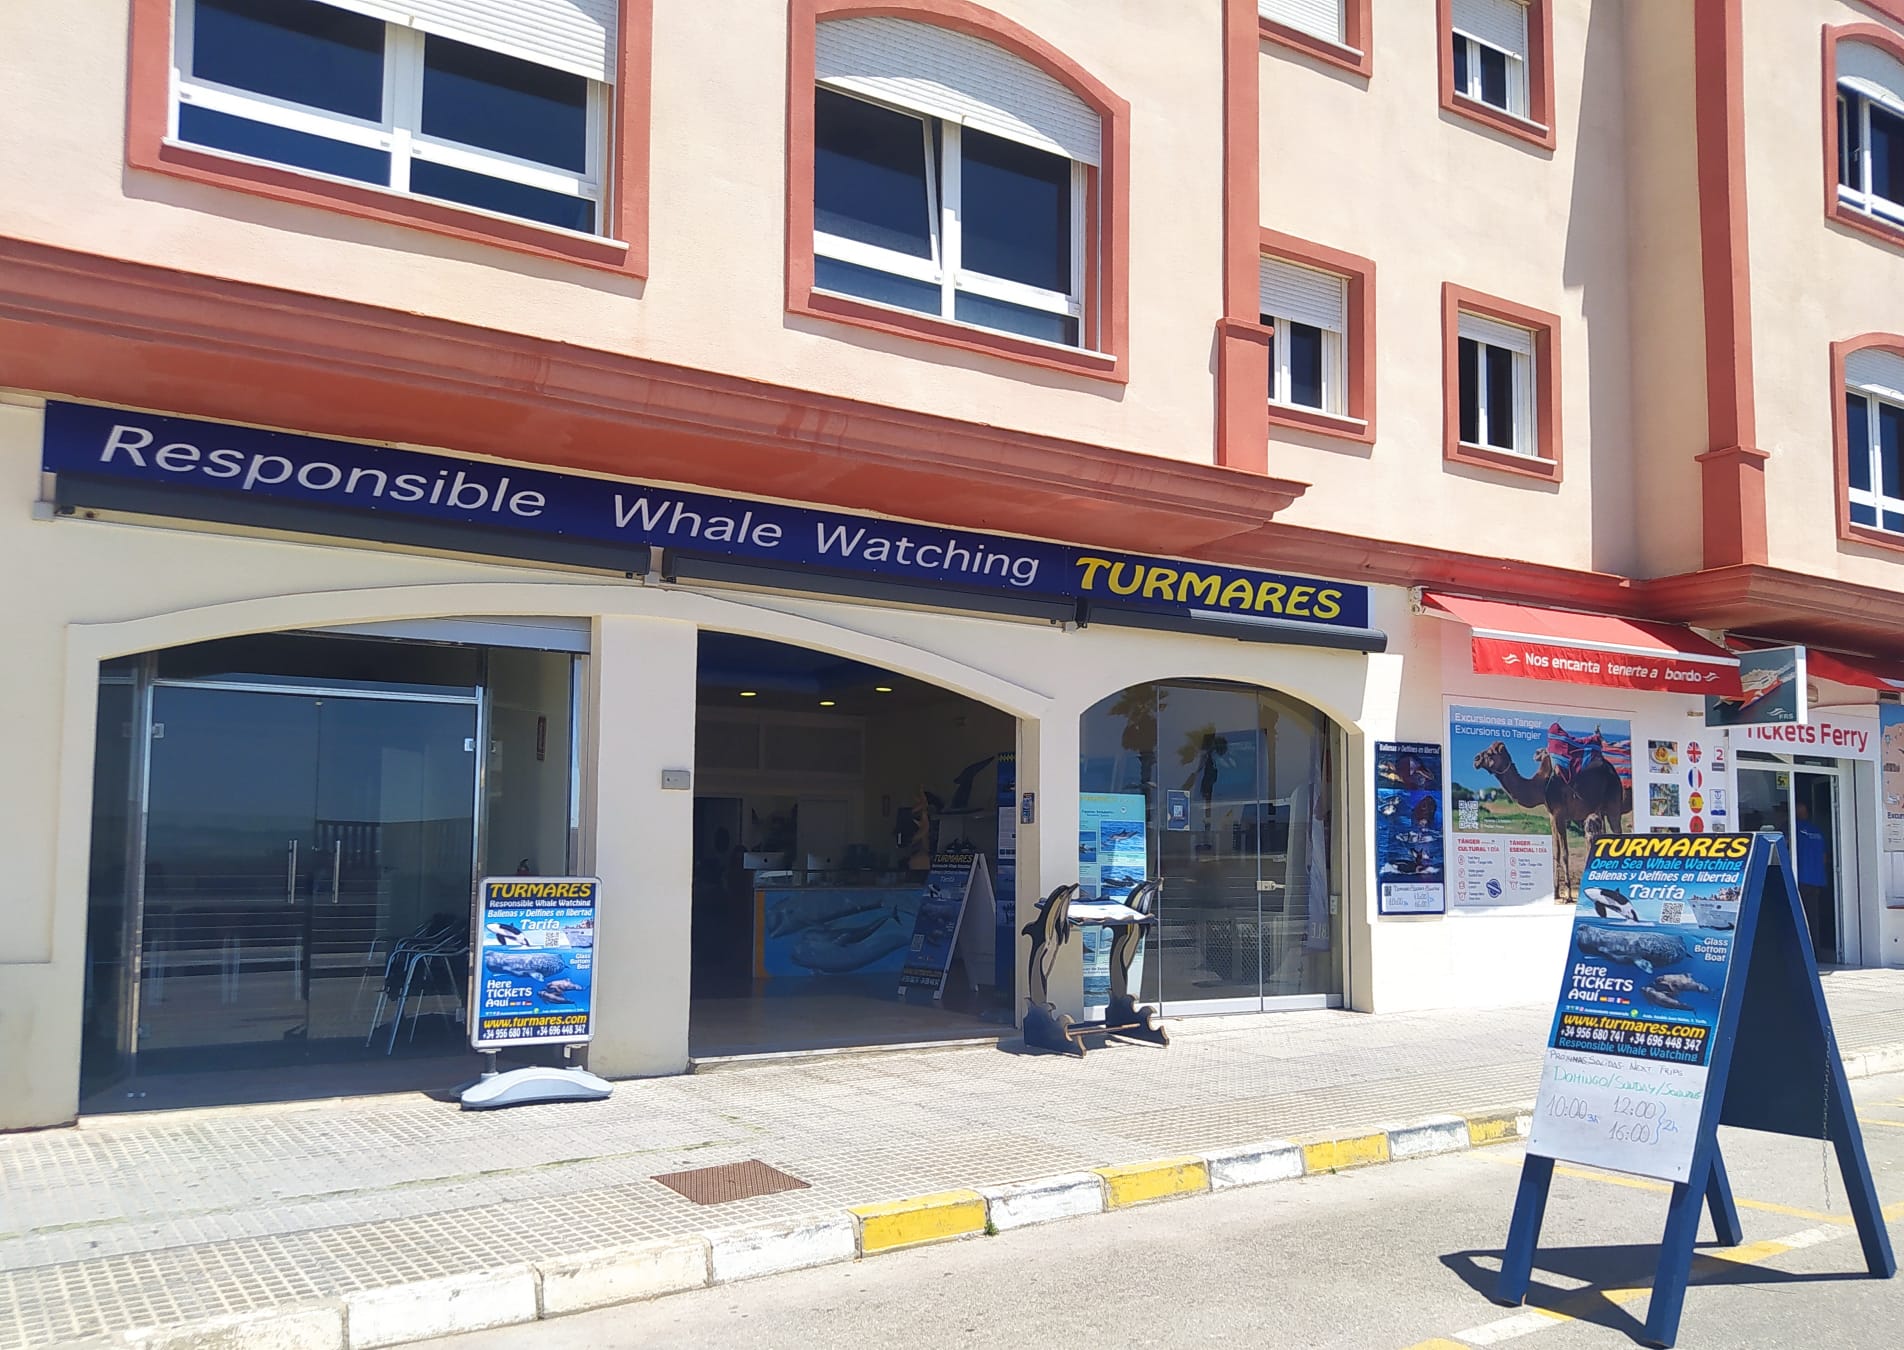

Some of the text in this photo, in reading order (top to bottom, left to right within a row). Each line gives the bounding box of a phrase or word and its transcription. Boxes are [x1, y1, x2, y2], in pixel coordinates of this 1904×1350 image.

[100, 424, 1040, 587] Responsible Whale Watching
[1075, 557, 1343, 619] TURMARES
[1525, 652, 1702, 683] Nos encanta tenerte a bordo
[1455, 712, 1505, 725] Excursiones
[1507, 718, 1513, 726] a
[1455, 724, 1542, 741] Excursions to Tangier
[1820, 723, 1869, 753] Ferry
[1715, 749, 1724, 761] 2
[1594, 837, 1750, 858] TURMARES
[935, 854, 974, 863] TURMARES
[1590, 857, 1743, 871] Open Sea Whale Watching
[1588, 870, 1739, 882] Ballenas y Delfines en libertad
[490, 883, 592, 898] TURMARES
[1628, 884, 1685, 900] Tarifa
[490, 900, 534, 908] Responsible
[535, 899, 557, 907] Whale
[488, 909, 518, 918] Ballenas
[525, 909, 554, 917] Delfines
[555, 909, 565, 917] en
[566, 908, 592, 917] libertad
[520, 919, 560, 930] Tarifa
[1703, 937, 1728, 946] Glass
[1694, 944, 1727, 954] Bottom
[1704, 953, 1726, 962] Boat
[1574, 963, 1608, 977] Here
[487, 979, 512, 989] Here
[1572, 975, 1633, 992] TICKETS
[486, 987, 533, 998] TICKETS
[1568, 988, 1600, 1002] Aquí
[485, 997, 510, 1008] Aquí
[483, 1015, 587, 1029] www.turmares.com
[1563, 1014, 1706, 1040] www.turmares.com
[482, 1027, 533, 1039] +34 956 680 741
[536, 1023, 586, 1036] +34 696 448 347
[1560, 1025, 1625, 1043] +34 956 680 741
[1629, 1032, 1702, 1051] +34 696 448 347
[1558, 1037, 1698, 1062] Responsible Whale Watching
[1547, 1094, 1599, 1124] 10:00 3h
[1613, 1095, 1657, 1120] 12:00
[1608, 1120, 1651, 1143] 16:00
[1662, 1120, 1679, 1133] 2h
